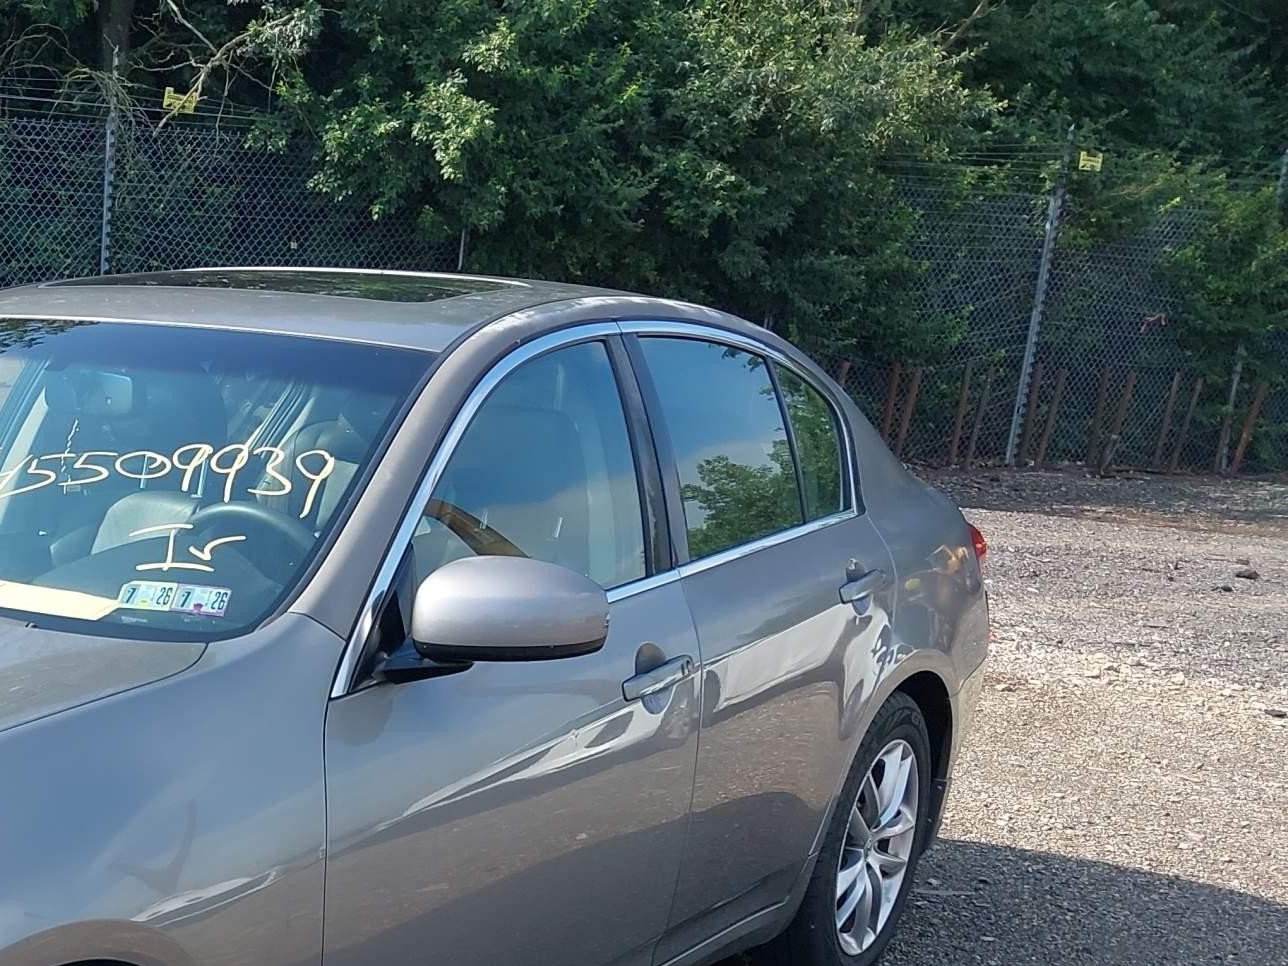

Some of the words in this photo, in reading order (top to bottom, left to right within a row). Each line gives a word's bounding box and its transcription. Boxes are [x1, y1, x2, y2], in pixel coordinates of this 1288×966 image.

[126, 588, 137, 604] 7
[155, 587, 173, 606] 26
[180, 591, 192, 608] 7
[210, 591, 229, 611] 26
